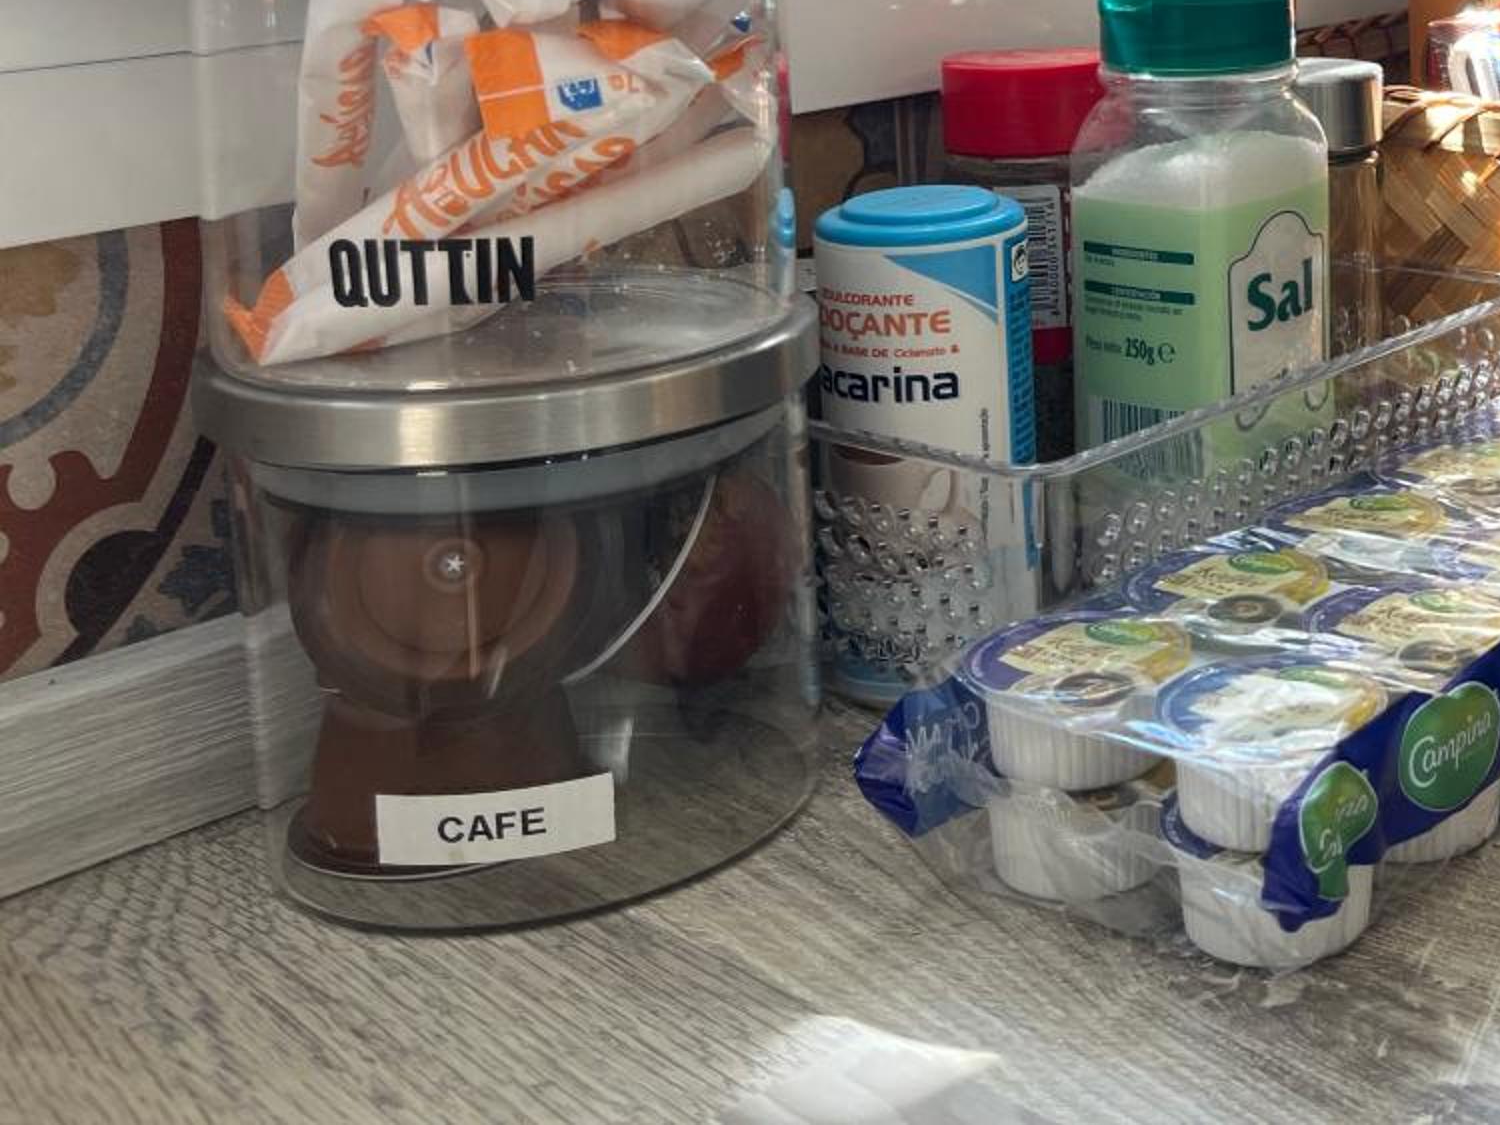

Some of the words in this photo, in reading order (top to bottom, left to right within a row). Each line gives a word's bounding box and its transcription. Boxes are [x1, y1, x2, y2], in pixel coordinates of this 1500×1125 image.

[328, 235, 536, 308] QUTTIN
[1247, 256, 1313, 332] Sal
[817, 364, 960, 403] acarina
[1409, 711, 1491, 788] Campina
[437, 806, 547, 844] CAFE
